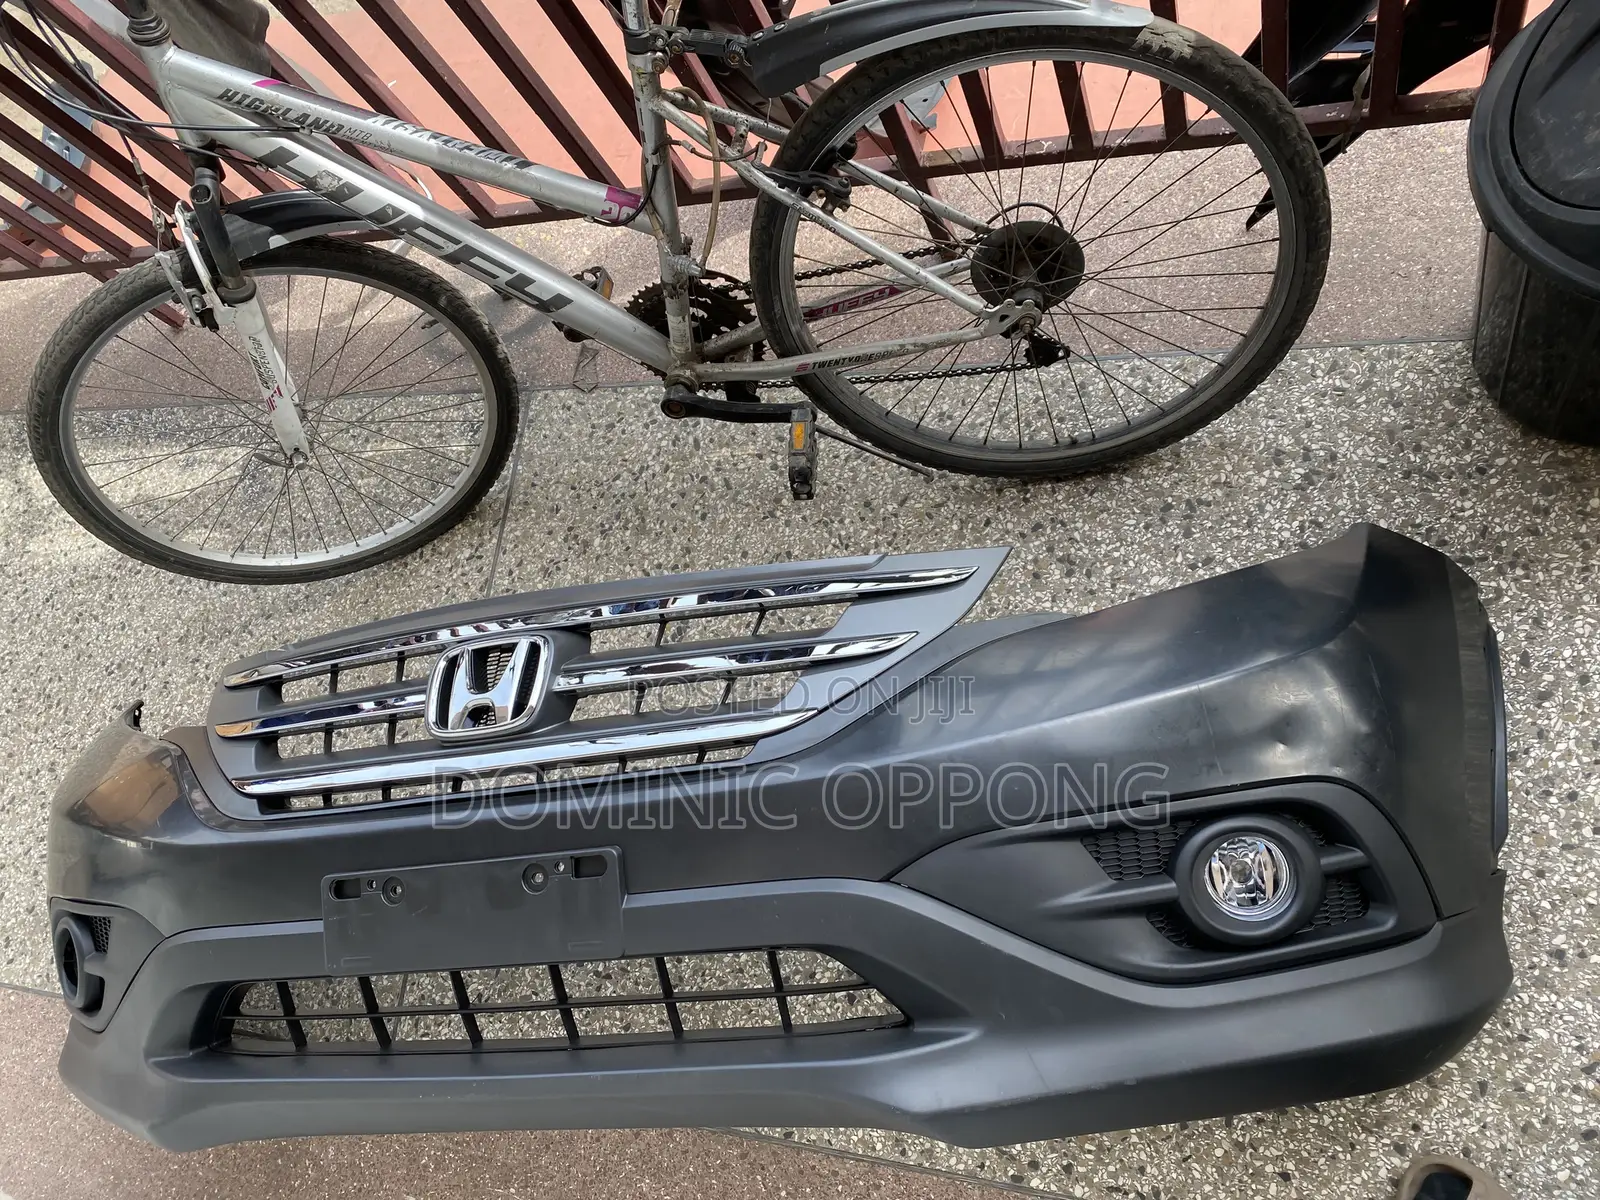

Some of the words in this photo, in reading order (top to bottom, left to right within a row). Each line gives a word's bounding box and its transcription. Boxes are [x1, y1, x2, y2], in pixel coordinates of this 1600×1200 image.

[217, 88, 344, 135] HIGHLAND
[344, 127, 373, 141] MTB
[258, 146, 574, 313] HUFFY
